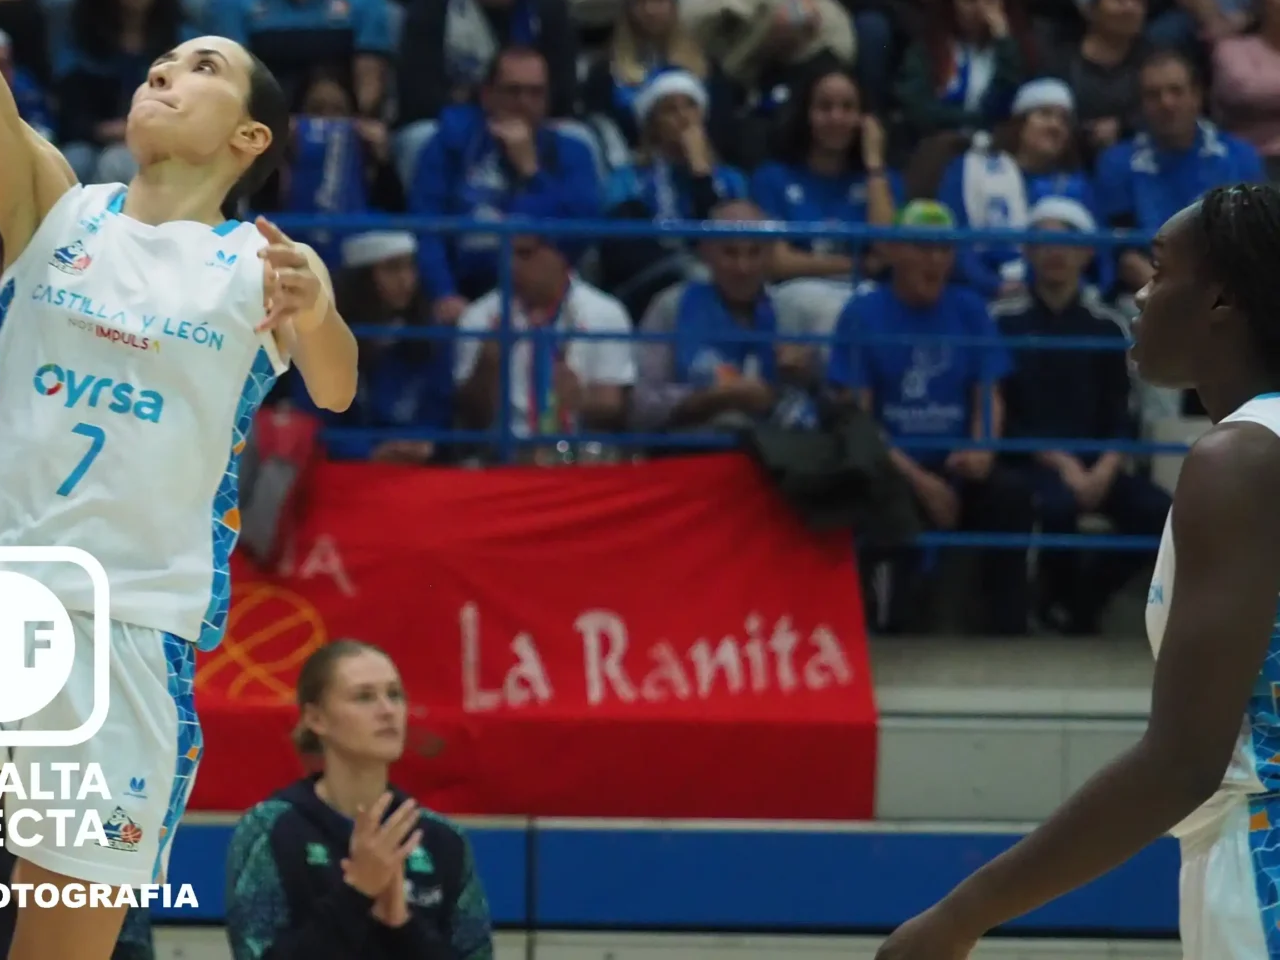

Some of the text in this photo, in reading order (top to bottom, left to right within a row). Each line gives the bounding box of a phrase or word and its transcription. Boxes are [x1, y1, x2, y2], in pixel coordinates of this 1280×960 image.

[32, 284, 225, 352] CASTILLA Y LEÓN
[56, 422, 106, 497] 7
[460, 600, 852, 713] La Ranita
